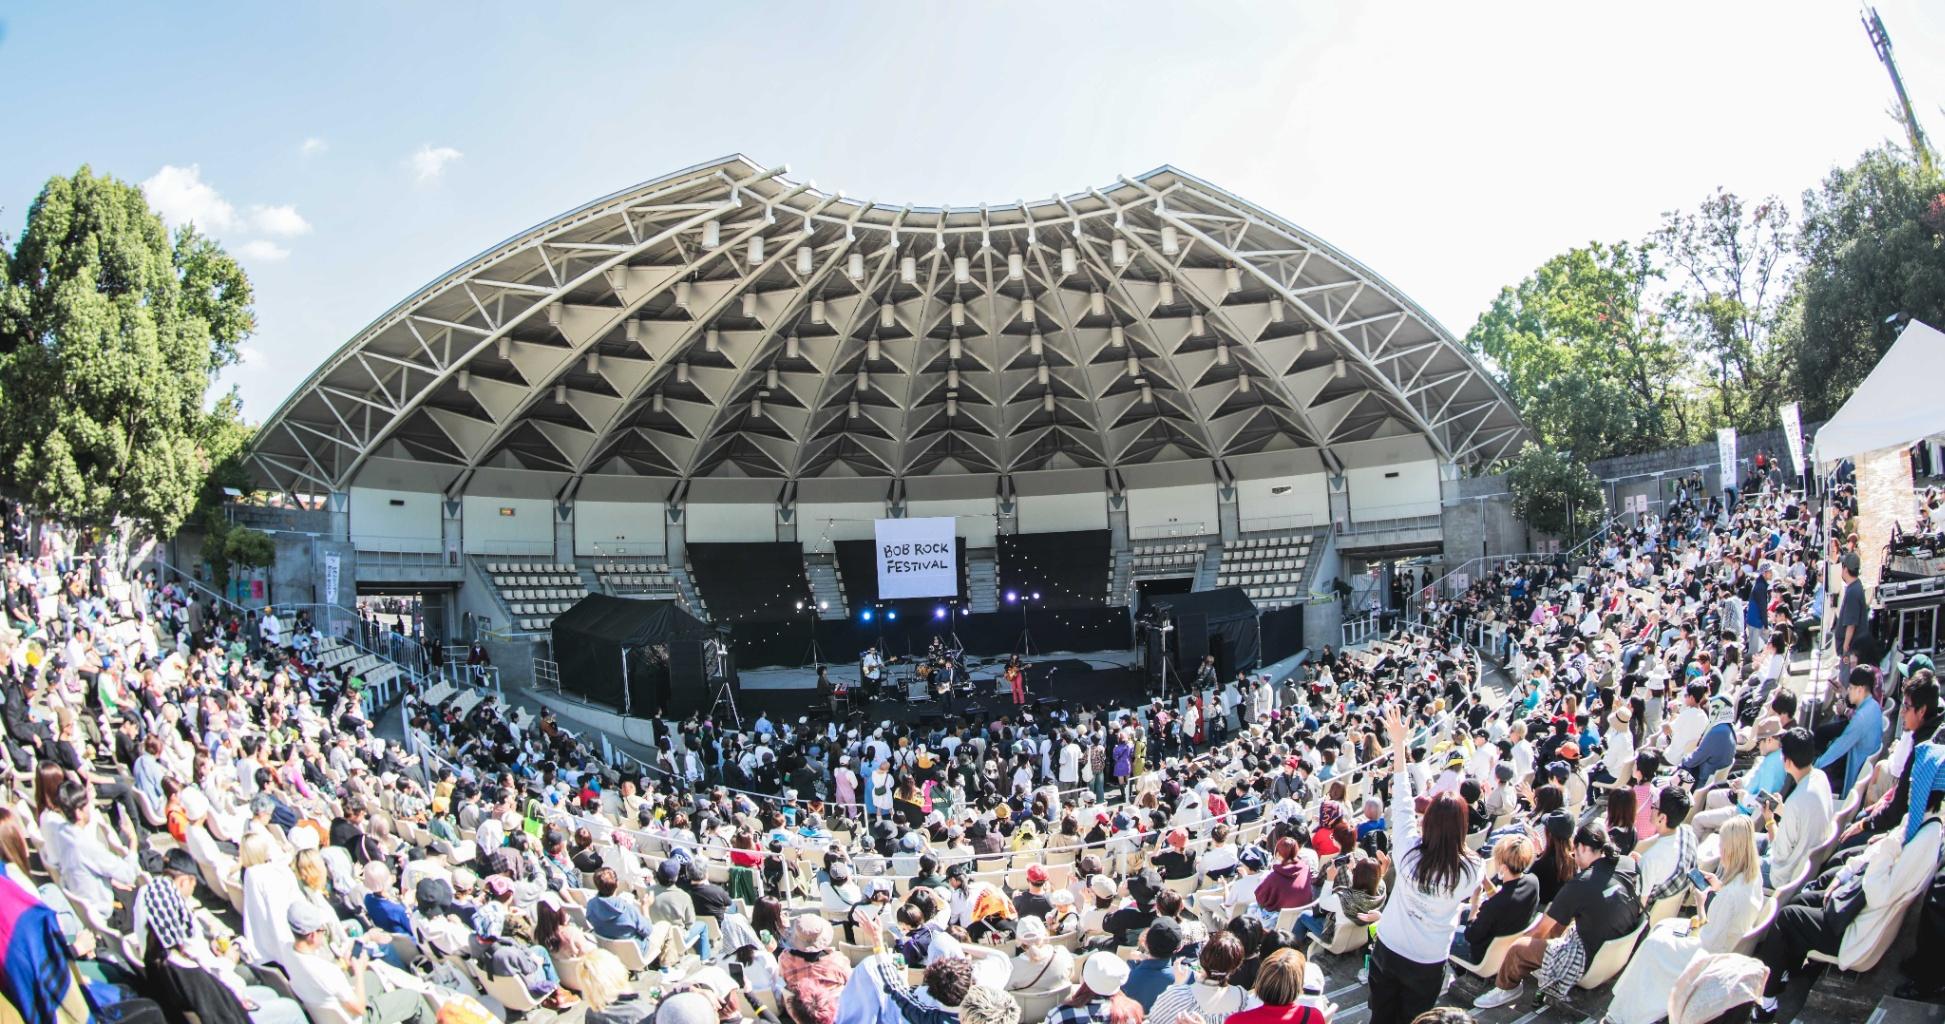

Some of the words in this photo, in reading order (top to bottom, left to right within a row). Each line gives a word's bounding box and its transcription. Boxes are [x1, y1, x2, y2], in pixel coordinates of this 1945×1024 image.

[883, 544, 910, 558] BOB
[915, 543, 949, 556] ROCK
[887, 560, 948, 573] FESTIVAL
